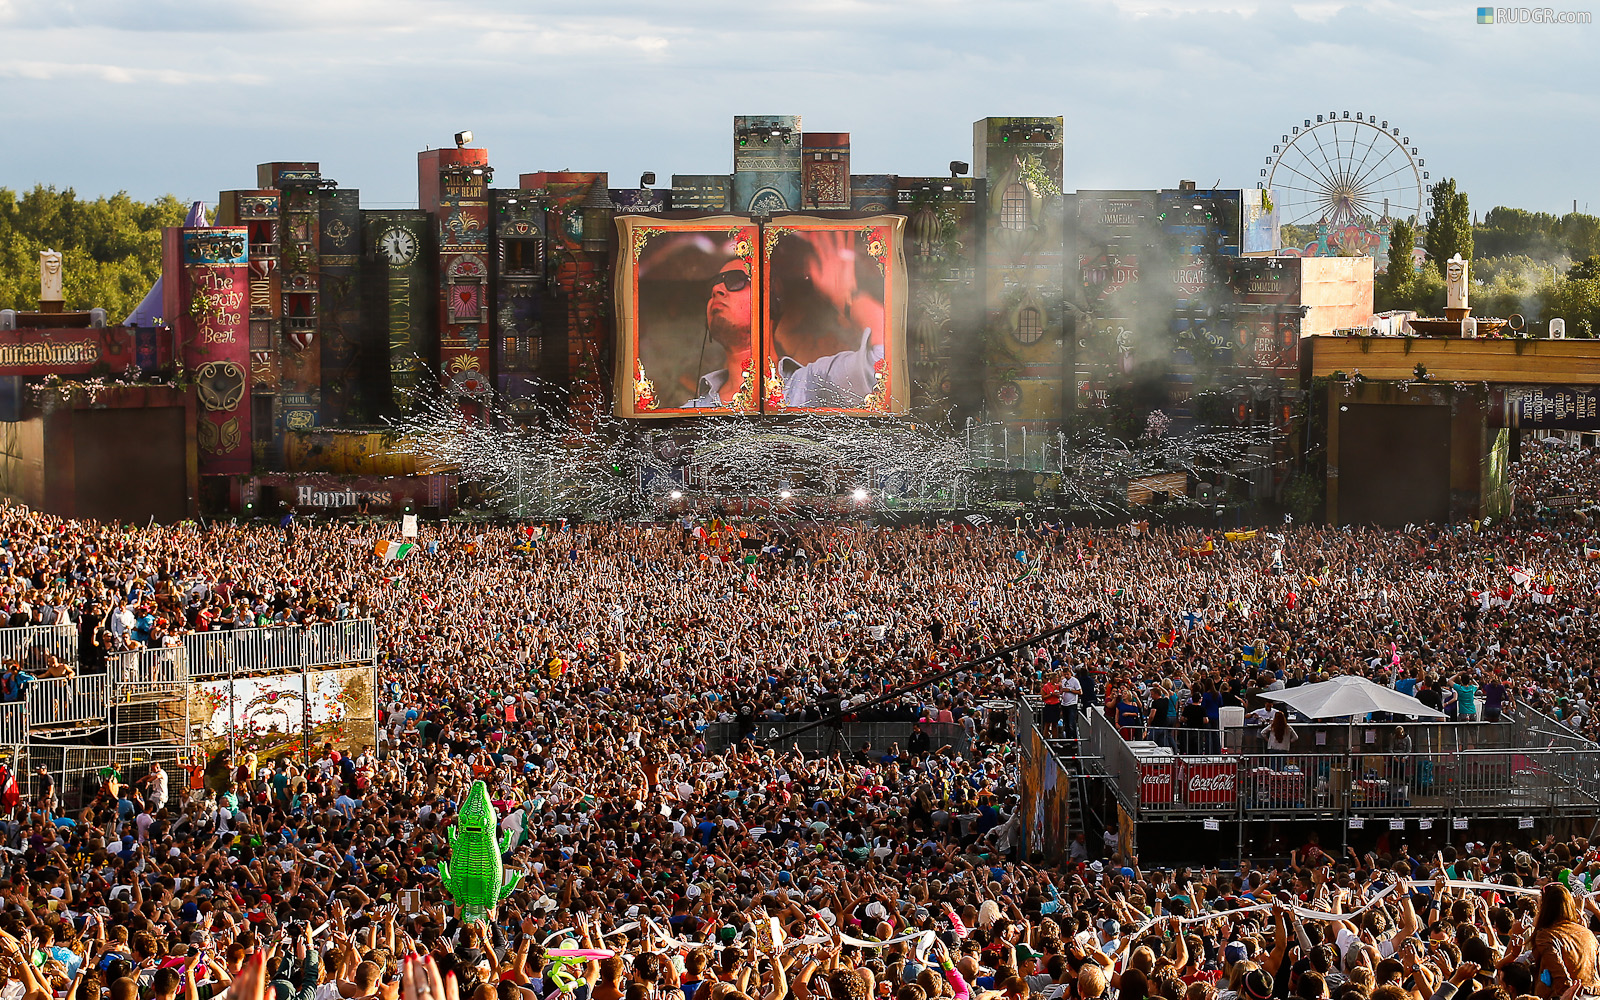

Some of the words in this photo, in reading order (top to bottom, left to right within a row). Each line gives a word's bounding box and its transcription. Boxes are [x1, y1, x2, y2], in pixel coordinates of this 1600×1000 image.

[445, 175, 464, 186] ALES
[466, 175, 482, 186] ROM
[462, 186, 482, 197] HEART
[200, 268, 233, 291] The
[250, 276, 270, 309] HOUSE
[217, 306, 241, 326] the
[201, 325, 236, 344] Beat
